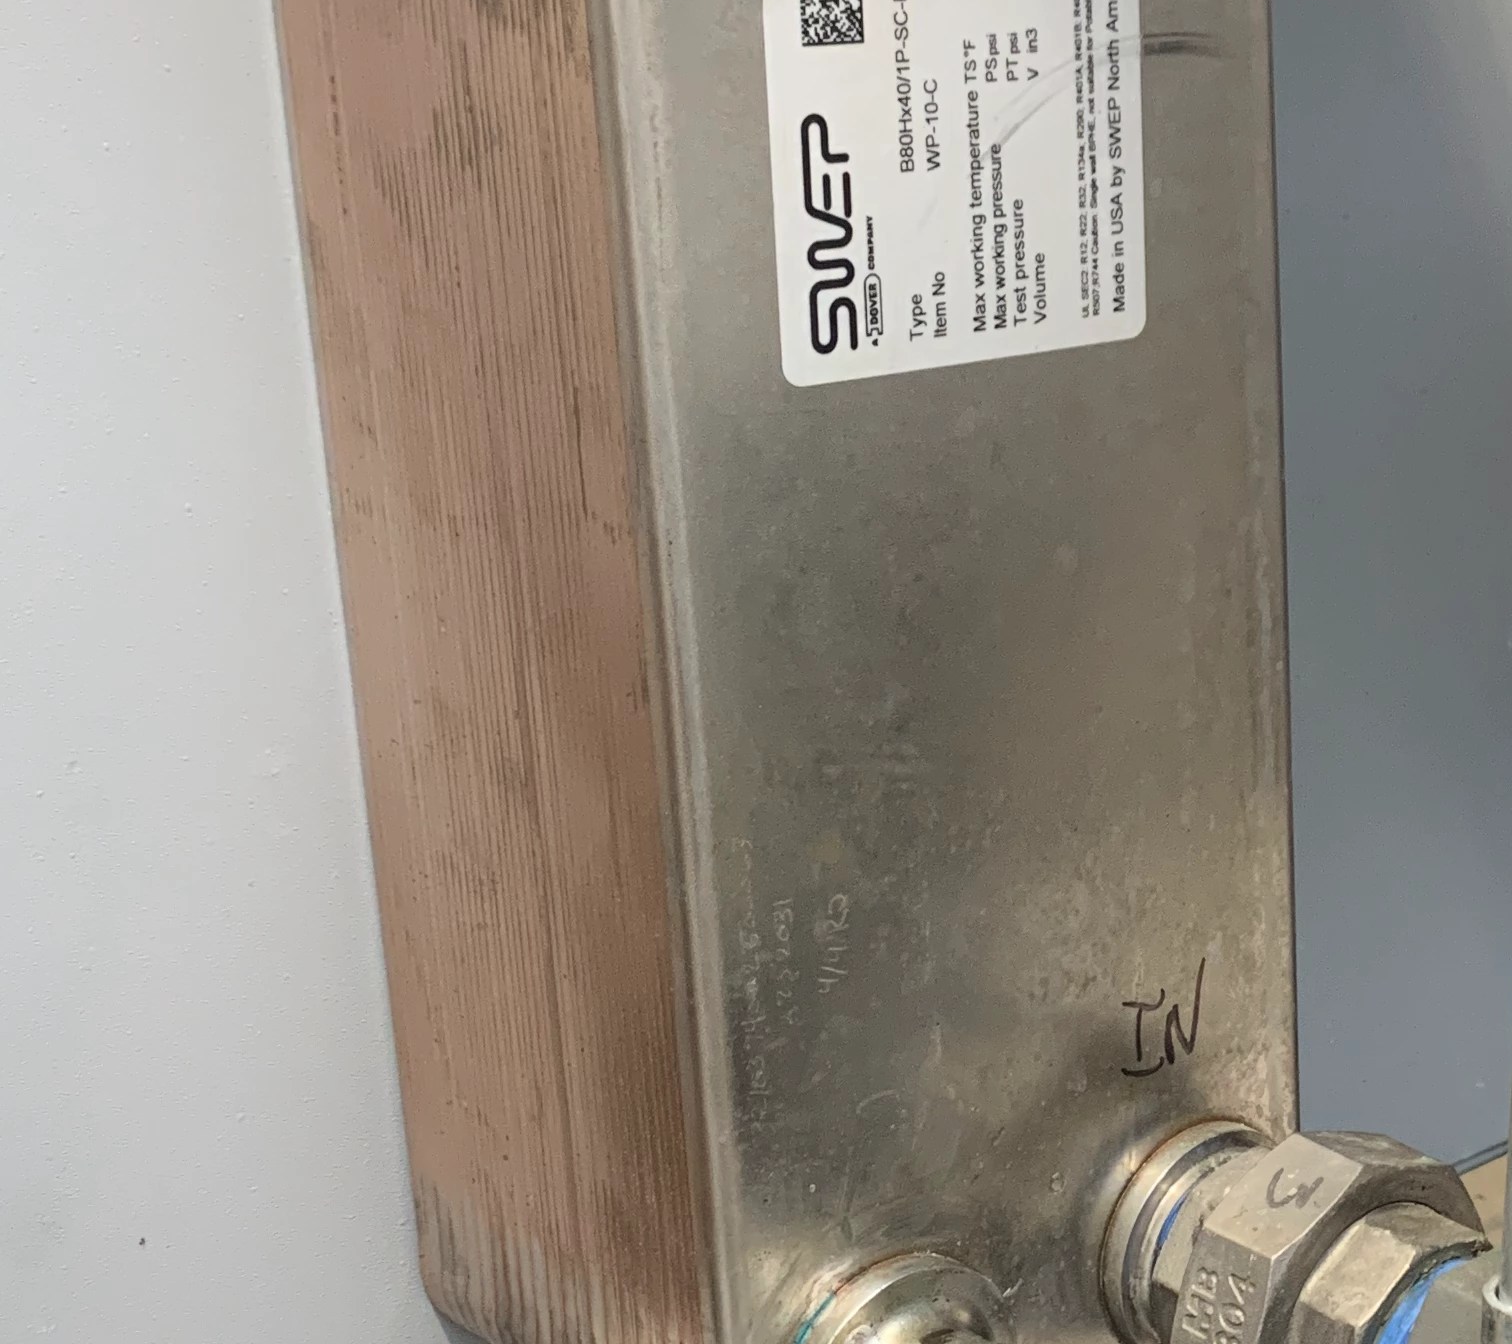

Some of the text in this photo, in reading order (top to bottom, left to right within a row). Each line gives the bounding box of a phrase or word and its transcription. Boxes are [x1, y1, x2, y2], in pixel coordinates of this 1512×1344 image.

[1026, 27, 1038, 52] in3
[1027, 66, 1039, 79] V
[1106, 38, 1120, 90] North
[923, 77, 940, 171] WP-10-C
[965, 89, 985, 207] temperature
[1108, 96, 1122, 158] SWEP
[989, 143, 1006, 216] pressure
[1089, 177, 1099, 207] Single
[1109, 165, 1126, 186] by
[800, 112, 858, 353] SWEP
[1110, 191, 1124, 234] USA
[865, 214, 875, 269] COMPANY
[969, 214, 987, 287] working
[990, 223, 1008, 288] working
[1011, 198, 1029, 278] pressure
[1111, 240, 1125, 256] in
[868, 282, 879, 324] DOVER
[932, 270, 946, 295] No
[1013, 286, 1027, 326] Test
[1032, 252, 1047, 323] Volume
[1112, 261, 1126, 311] Made
[909, 293, 927, 340] Type
[933, 300, 947, 337] Item
[973, 292, 987, 331] Max
[993, 290, 1007, 328] Max
[1121, 956, 1206, 1077] IN
